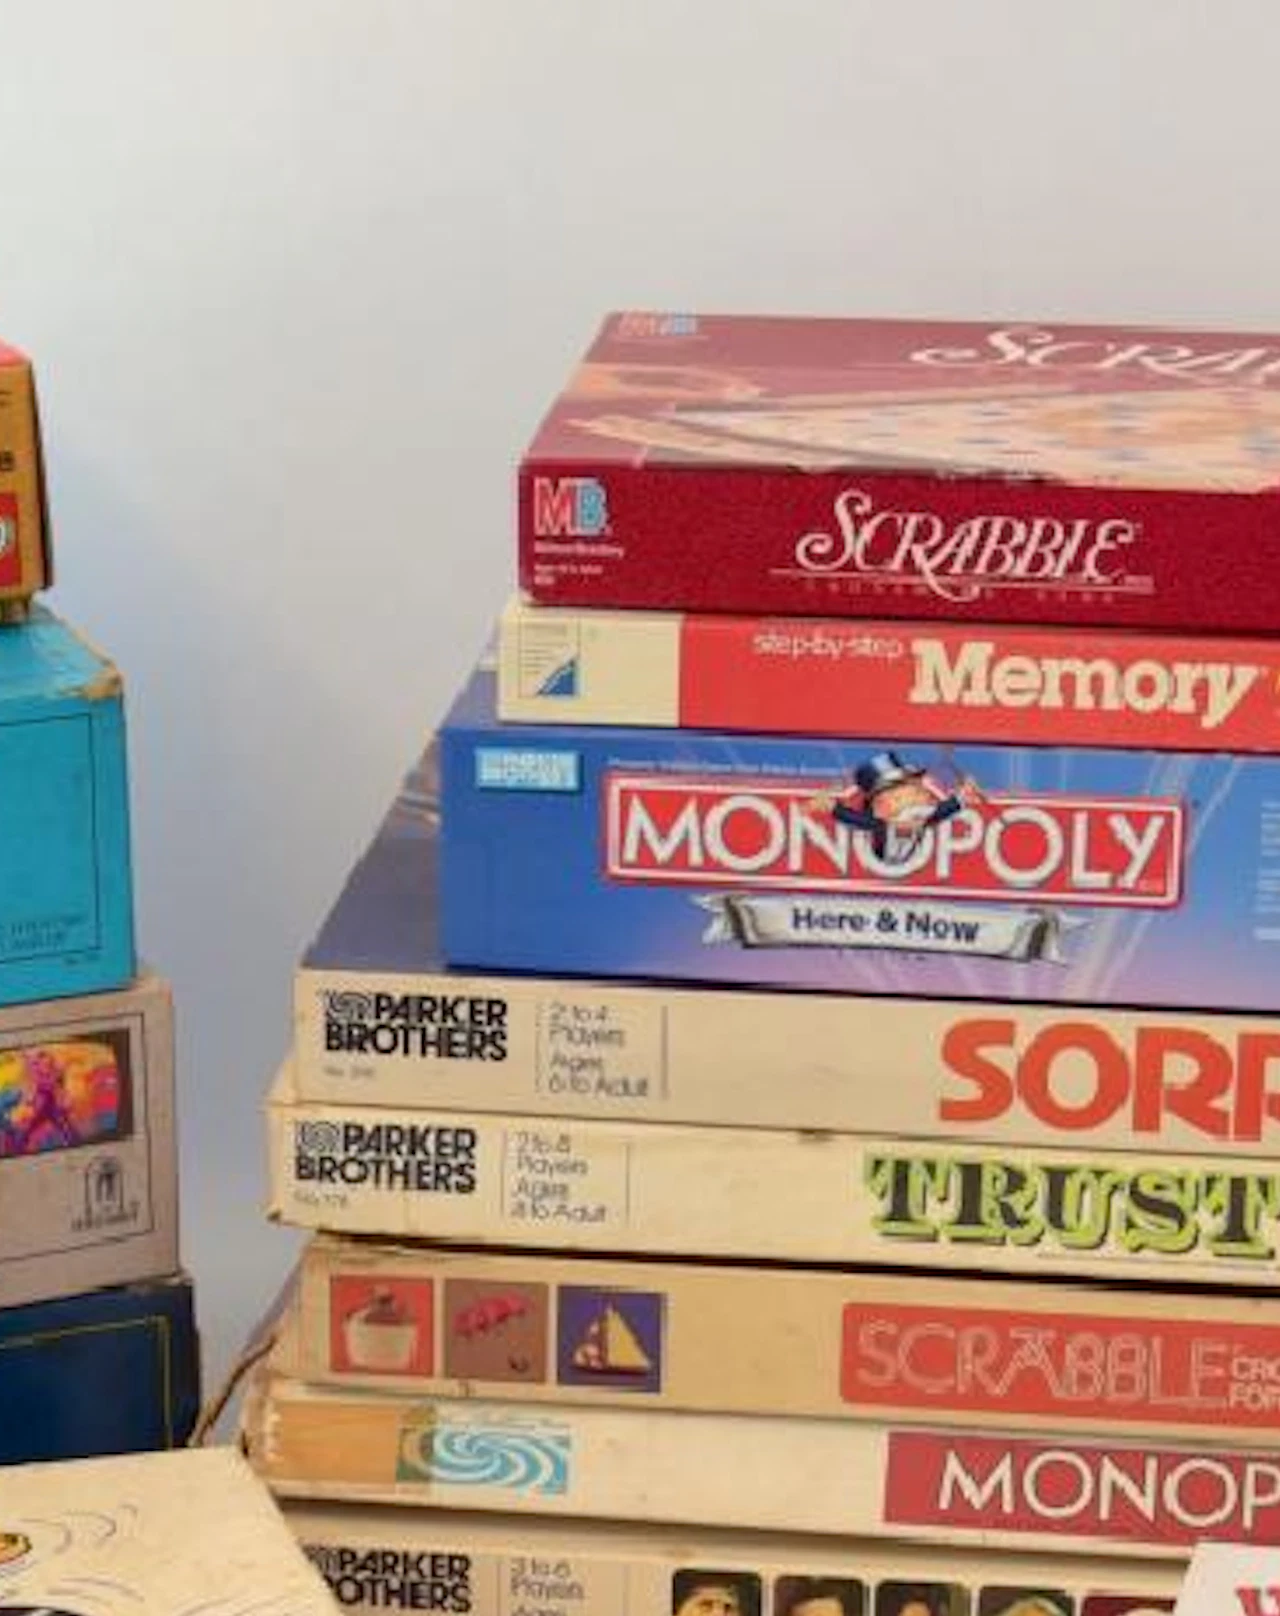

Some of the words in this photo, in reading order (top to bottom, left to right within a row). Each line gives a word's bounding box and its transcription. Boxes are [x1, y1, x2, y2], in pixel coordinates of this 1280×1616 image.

[534, 476, 608, 537] MB
[794, 488, 1136, 602] SCRABBLE
[752, 632, 904, 660] step-by-step
[908, 637, 1262, 729] Memory
[790, 907, 868, 932] Here
[875, 909, 899, 933] &
[905, 911, 981, 943] Now
[373, 993, 508, 1028] PARKER
[324, 1021, 508, 1062] BROTHERS
[342, 1122, 477, 1159] PARKER
[295, 1154, 477, 1194] BROTHERS
[857, 1320, 1228, 1408] SCRABBLE
[338, 1549, 472, 1582] PARKER
[324, 1574, 473, 1613] OTHERS
